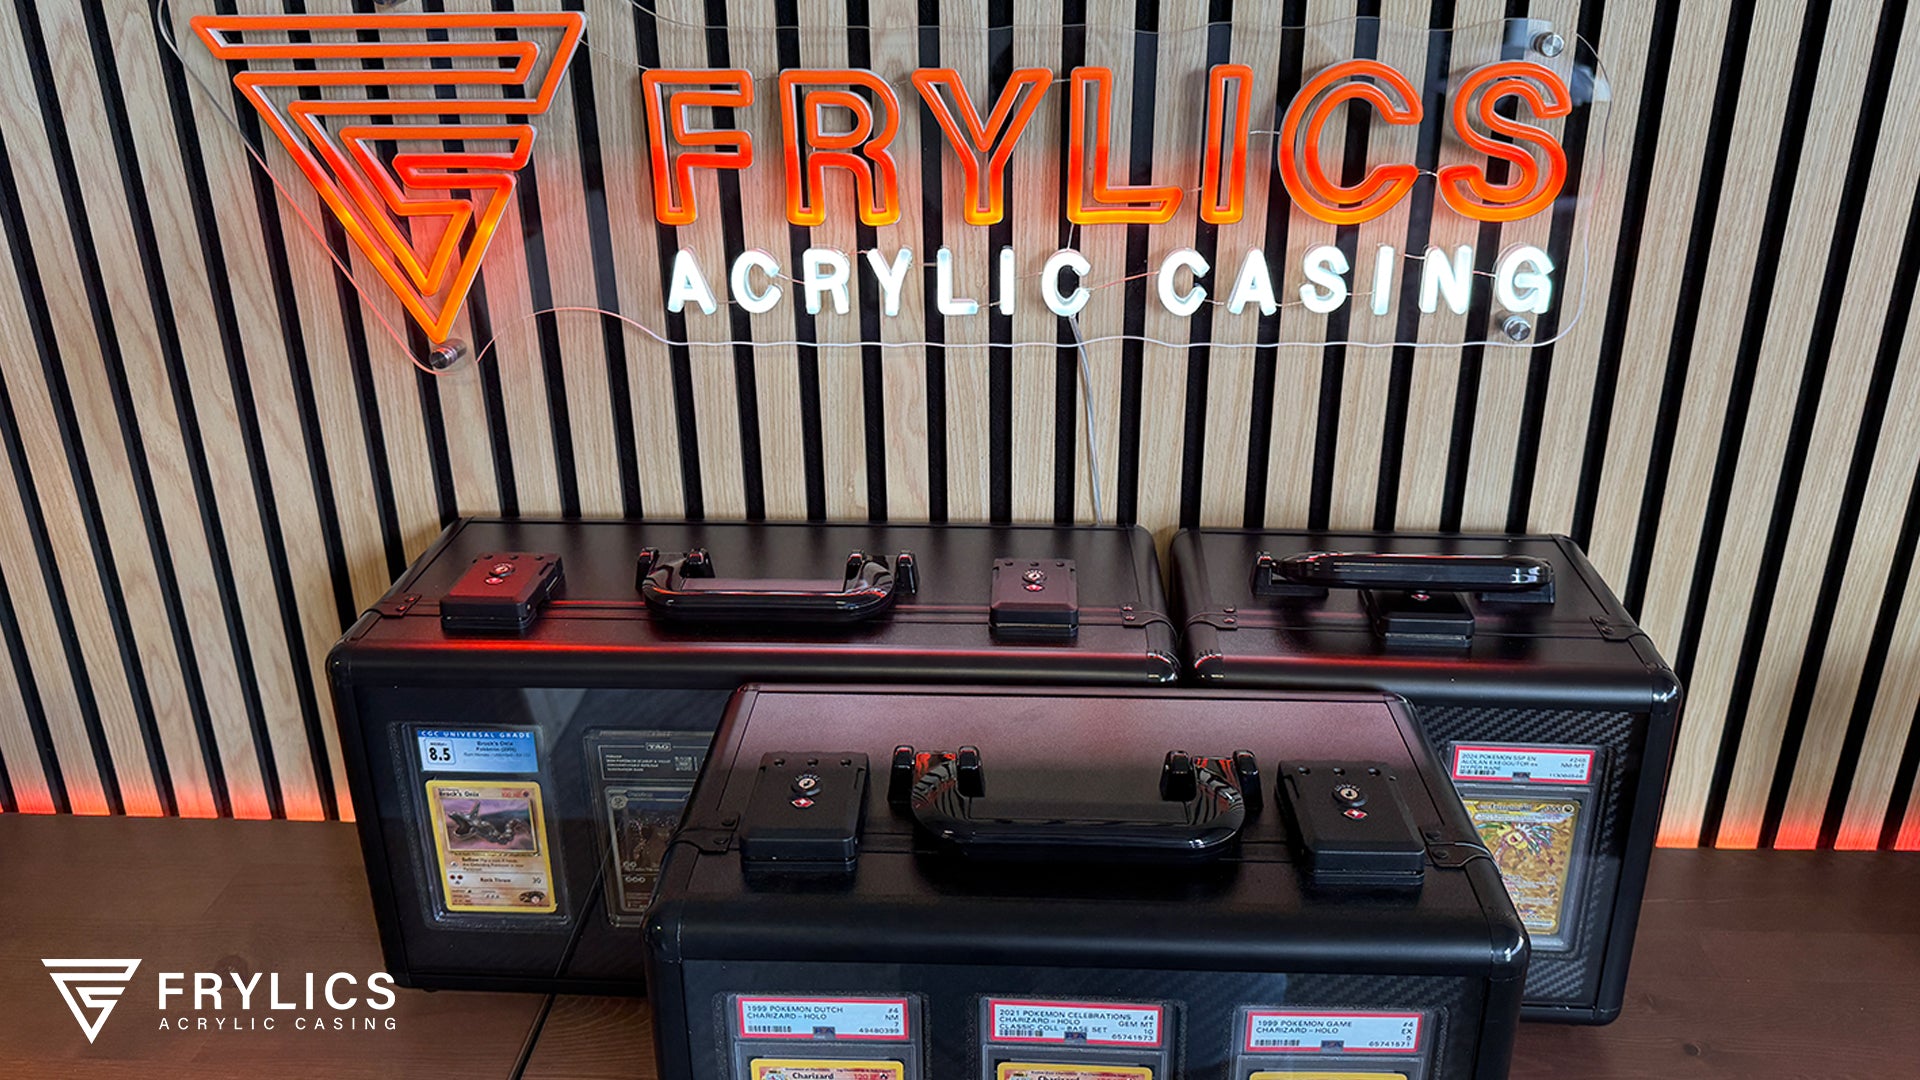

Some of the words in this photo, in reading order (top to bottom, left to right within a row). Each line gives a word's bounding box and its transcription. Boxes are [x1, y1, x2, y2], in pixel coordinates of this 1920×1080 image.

[641, 58, 1572, 226] FRYLICS
[667, 245, 1091, 317] ACRYLIC
[1156, 243, 1554, 317] CASING
[500, 731, 531, 739] GRADE
[429, 747, 451, 761] 8.5
[748, 1005, 768, 1013] 1999
[1023, 1010, 1066, 1018] POKEMON
[1068, 1012, 1132, 1021] CELEBRATIONS
[999, 1016, 1050, 1024] CHARIZARD
[1327, 1020, 1352, 1028] GAME
[999, 1023, 1037, 1031] CLASSIC
[792, 1072, 834, 1080] Charizard
